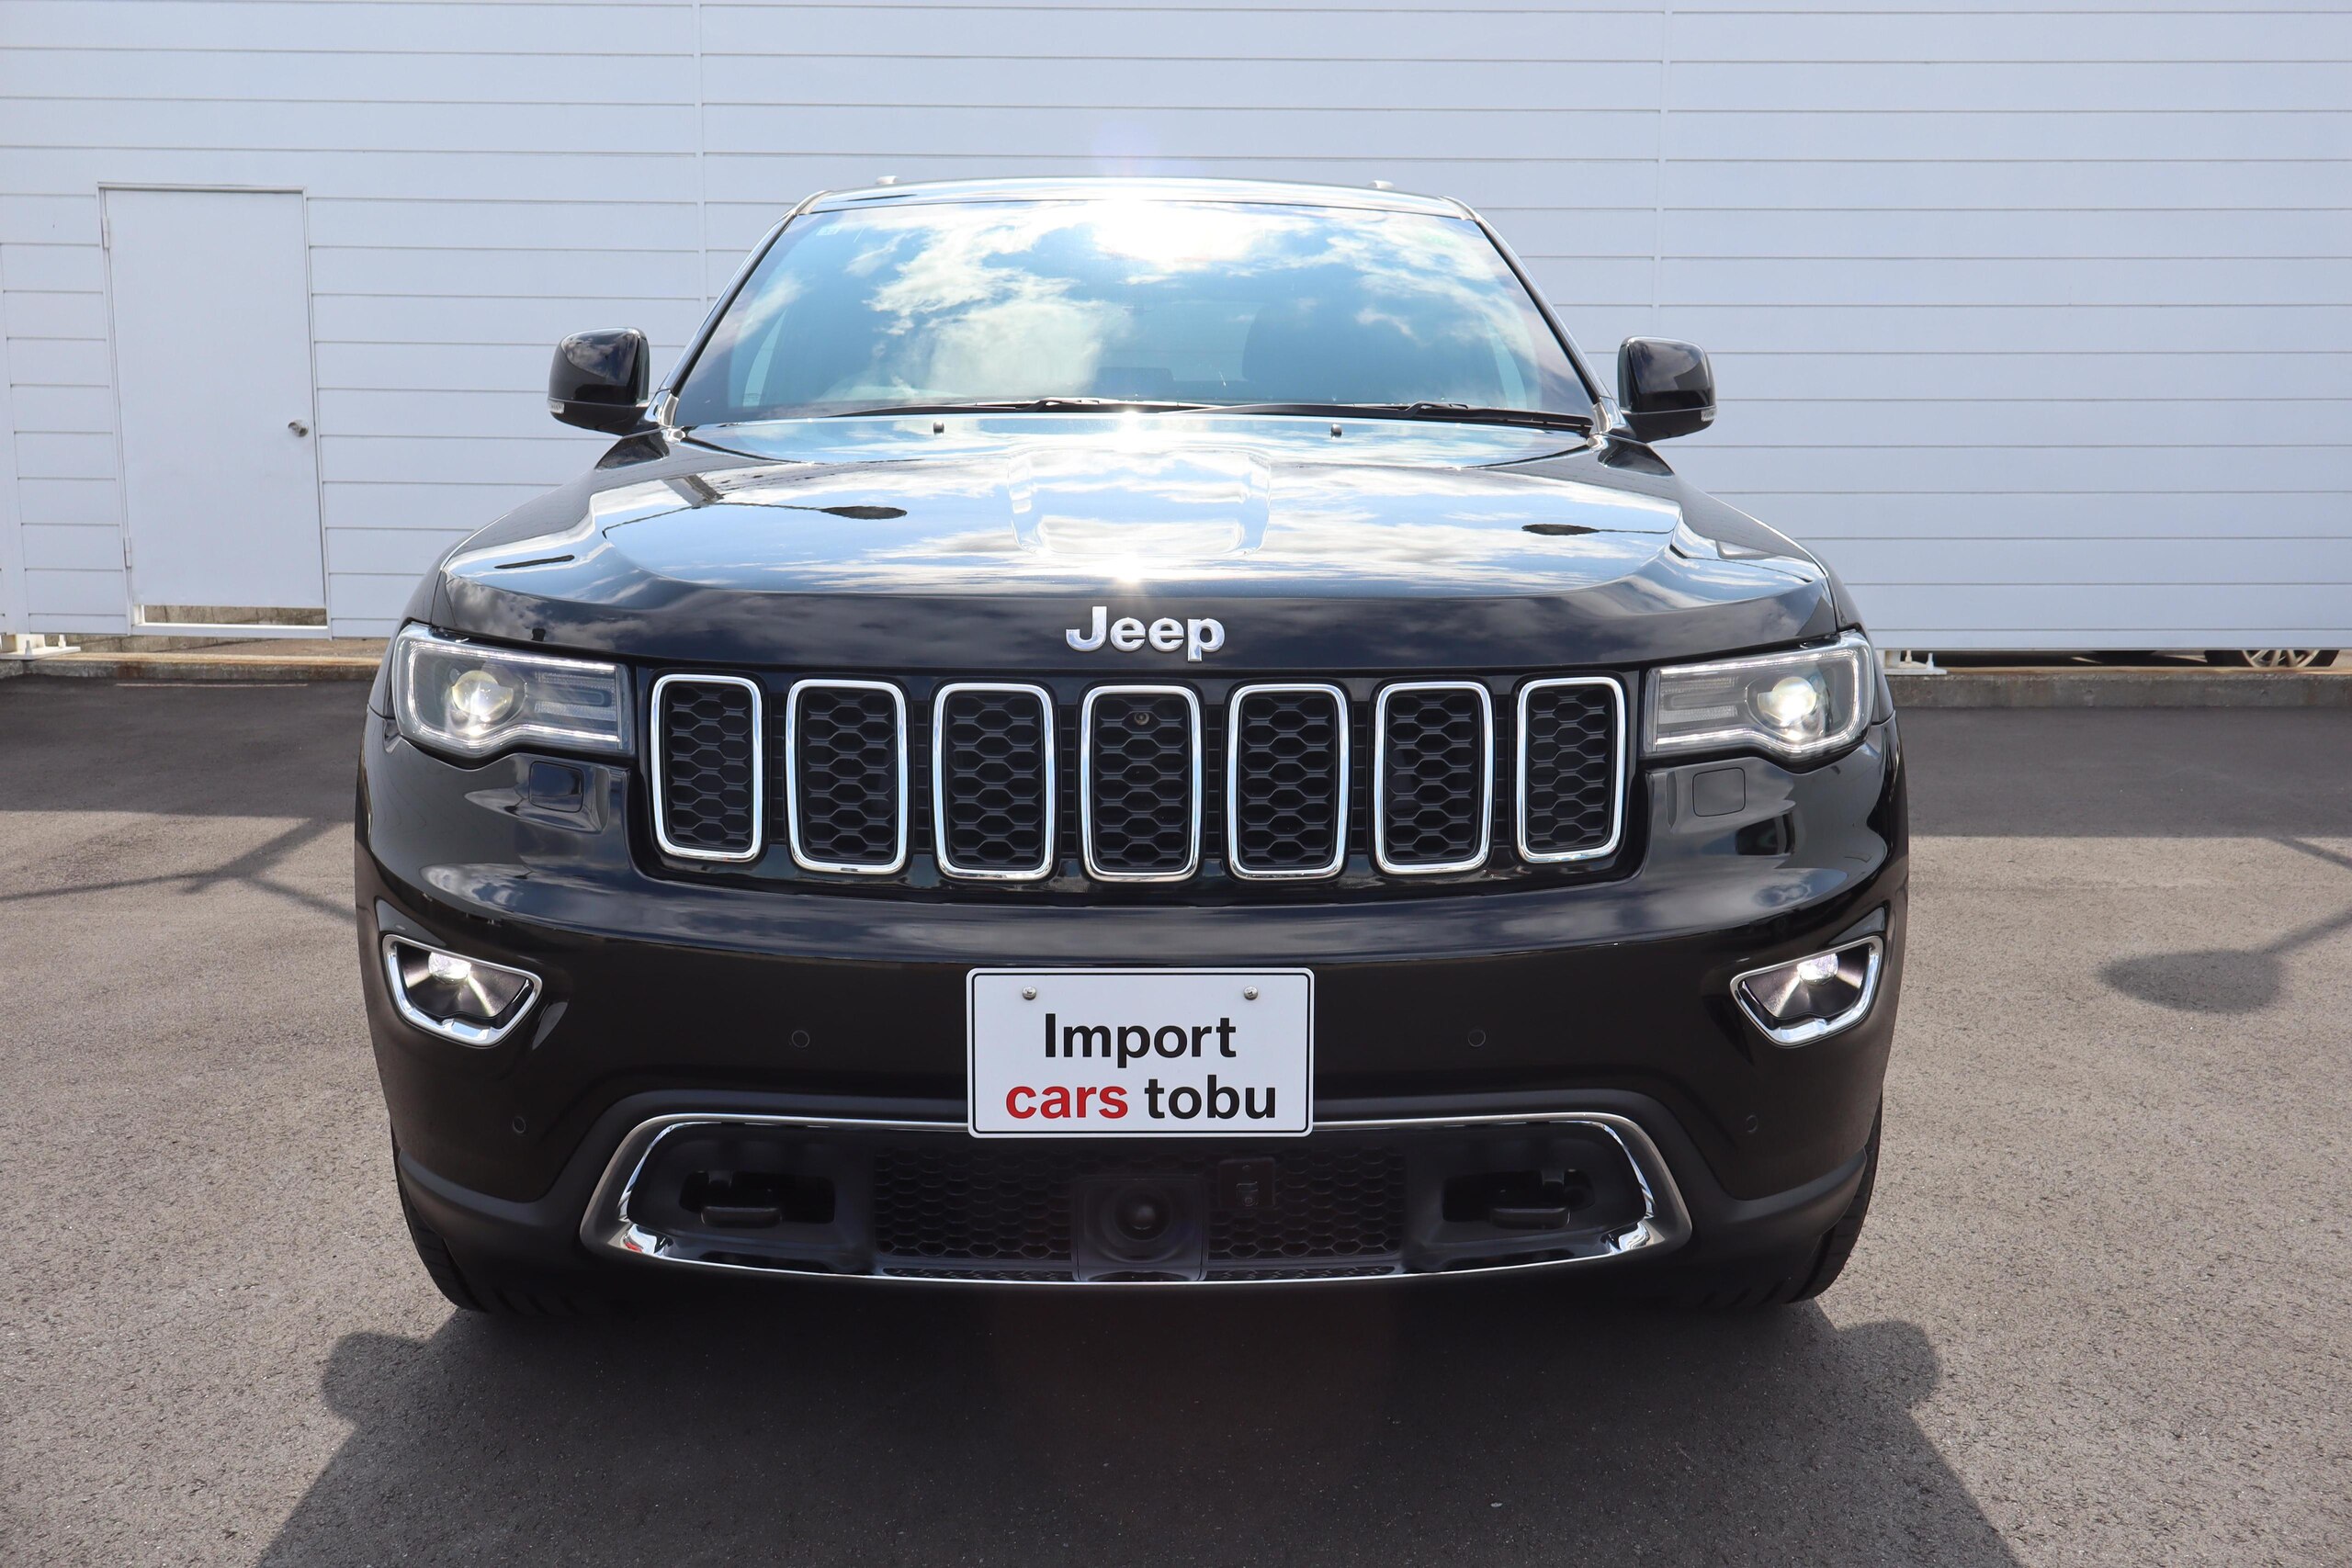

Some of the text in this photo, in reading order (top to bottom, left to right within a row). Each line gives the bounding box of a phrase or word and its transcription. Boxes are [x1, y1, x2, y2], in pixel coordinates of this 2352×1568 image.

[1065, 605, 1226, 662] Jeep
[1045, 1012, 1237, 1069] Import
[1005, 1074, 1276, 1120] cars tobu
